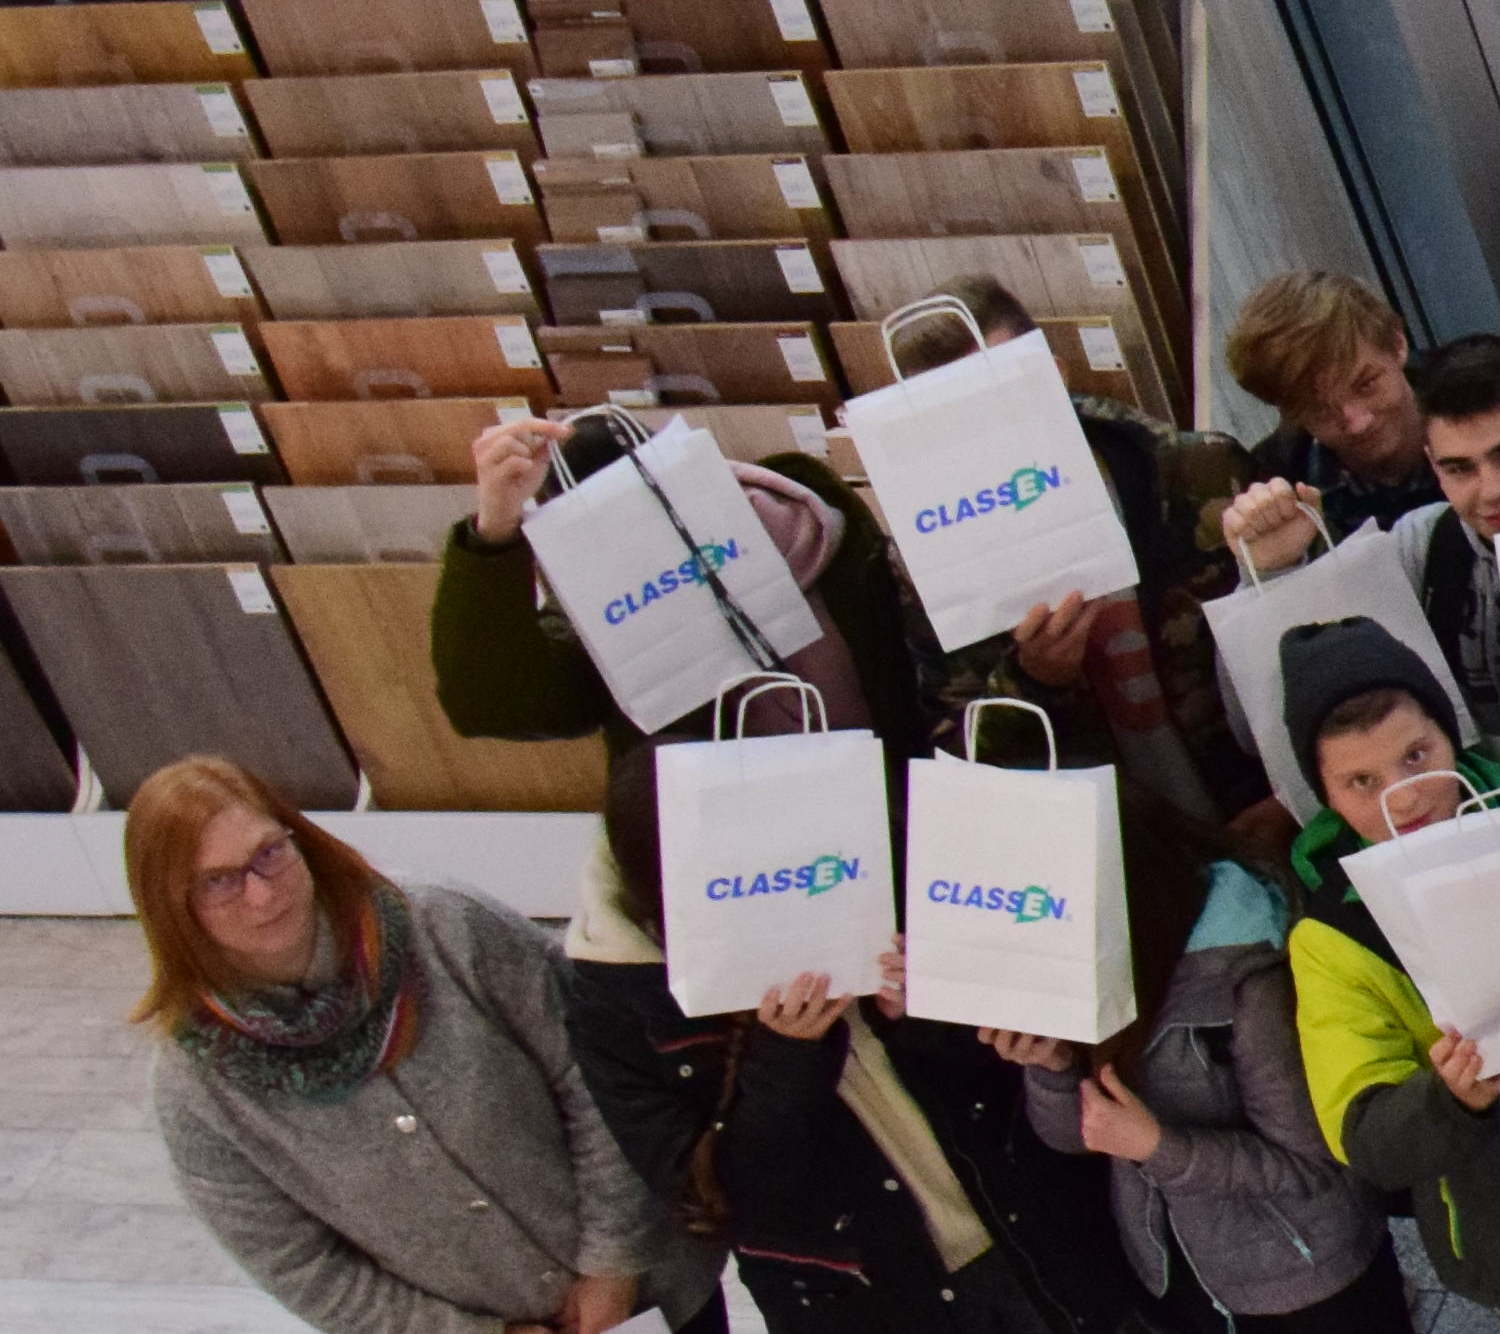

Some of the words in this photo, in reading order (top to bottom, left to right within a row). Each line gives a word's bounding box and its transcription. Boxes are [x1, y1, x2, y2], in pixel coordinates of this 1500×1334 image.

[916, 468, 1059, 533] CLASSEN
[707, 856, 858, 900] CLASSEN
[928, 881, 1064, 922] CLASSEN
